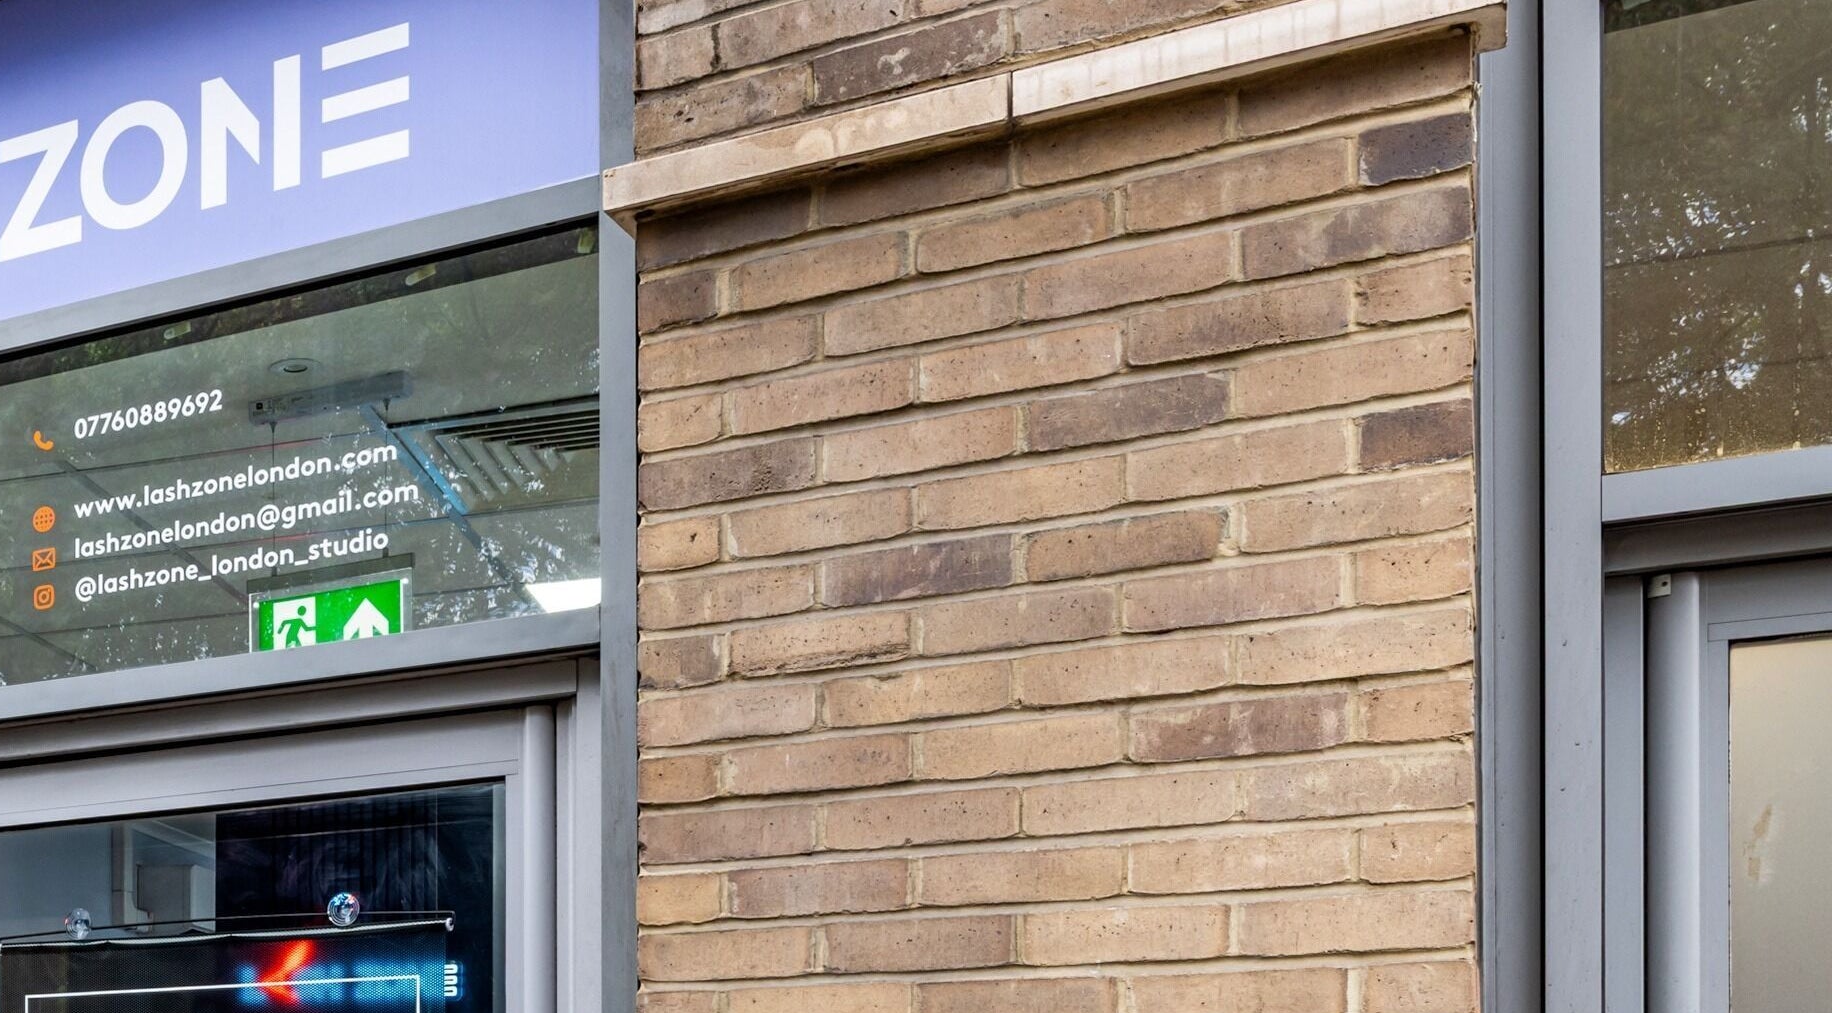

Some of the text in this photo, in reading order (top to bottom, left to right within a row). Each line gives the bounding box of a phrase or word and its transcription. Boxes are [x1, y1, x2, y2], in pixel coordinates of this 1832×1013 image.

[0, 22, 410, 263] ZONE
[74, 389, 223, 439] 07760889692
[74, 443, 398, 519] www.lashzonelondon.com
[74, 484, 419, 559] lashzonelondon@gmail.com
[75, 529, 389, 603] @lashzone_london_studio
